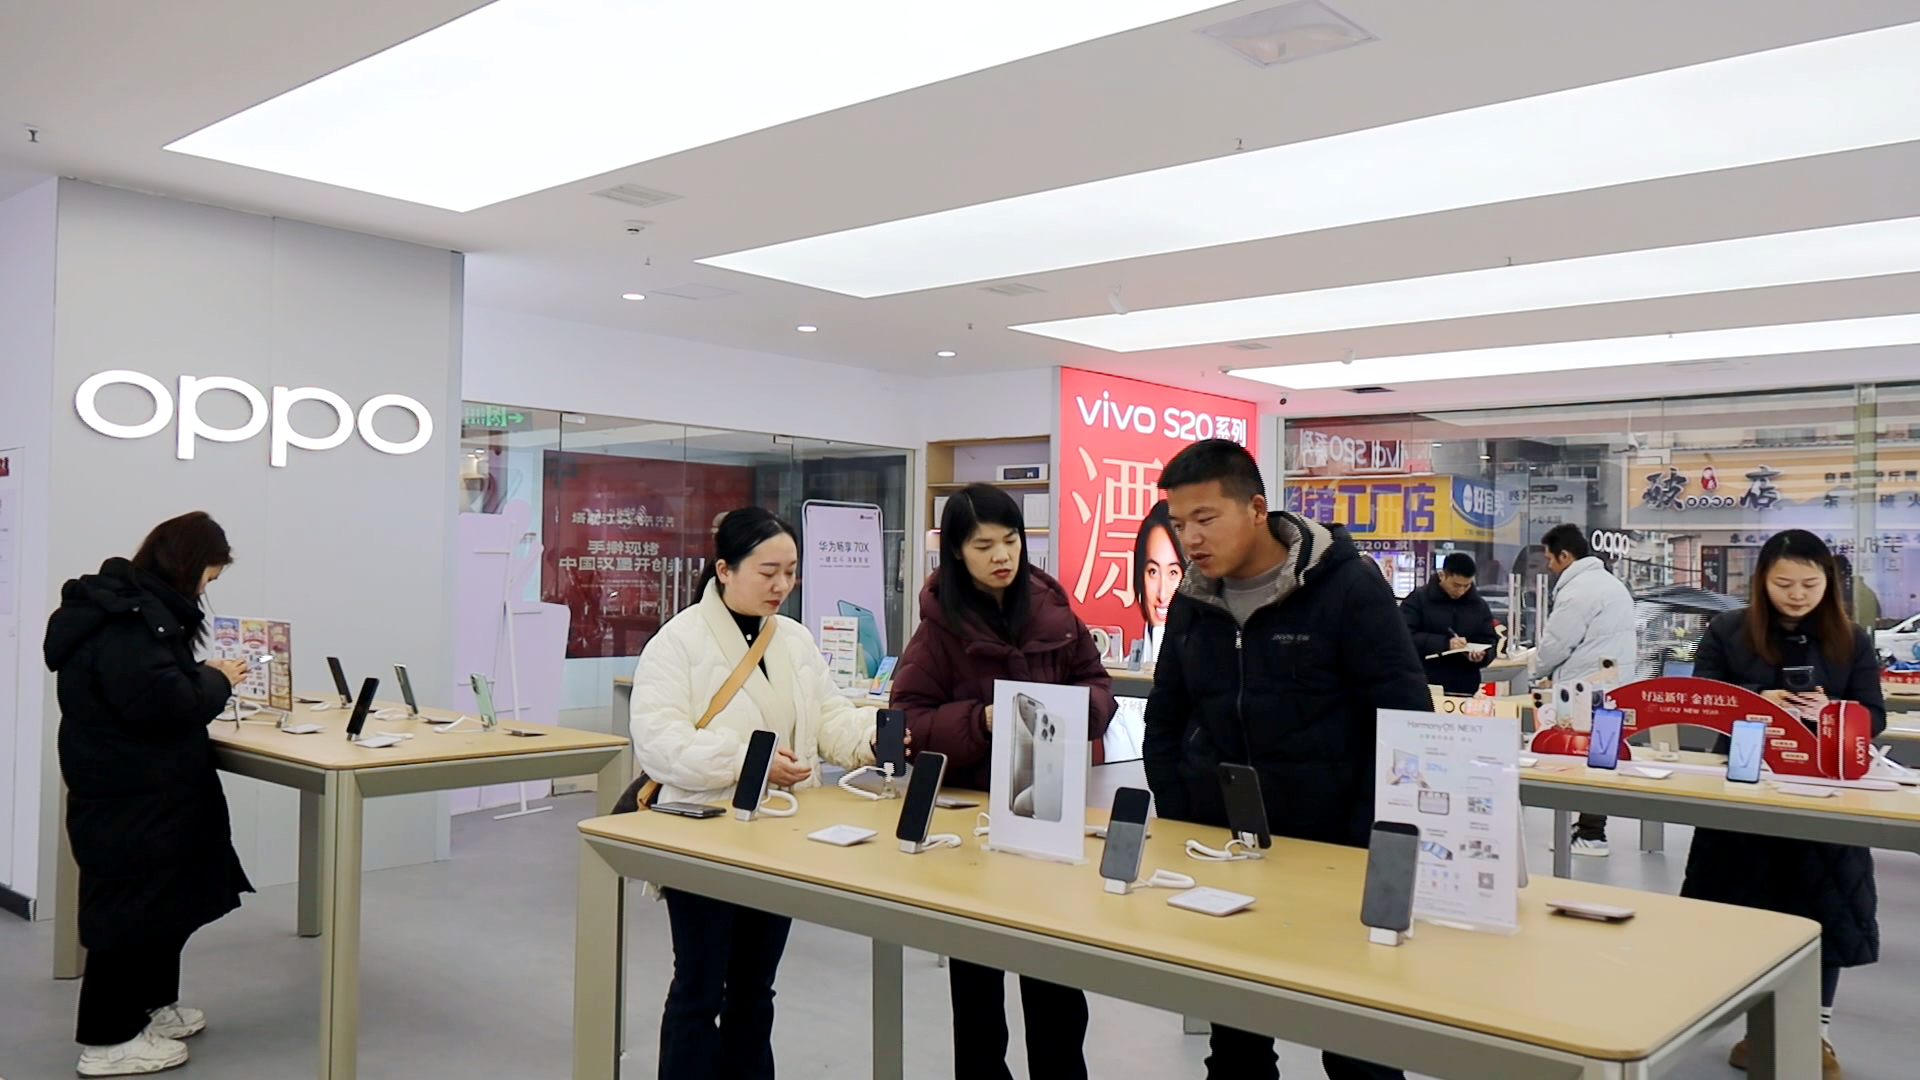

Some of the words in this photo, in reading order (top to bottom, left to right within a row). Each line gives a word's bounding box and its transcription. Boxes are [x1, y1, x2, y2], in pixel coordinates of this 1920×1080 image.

[74, 370, 433, 467] oppo
[1076, 390, 1156, 434] vivo
[1163, 407, 1247, 448] S20系列
[1855, 736, 1866, 766] LUCKY
